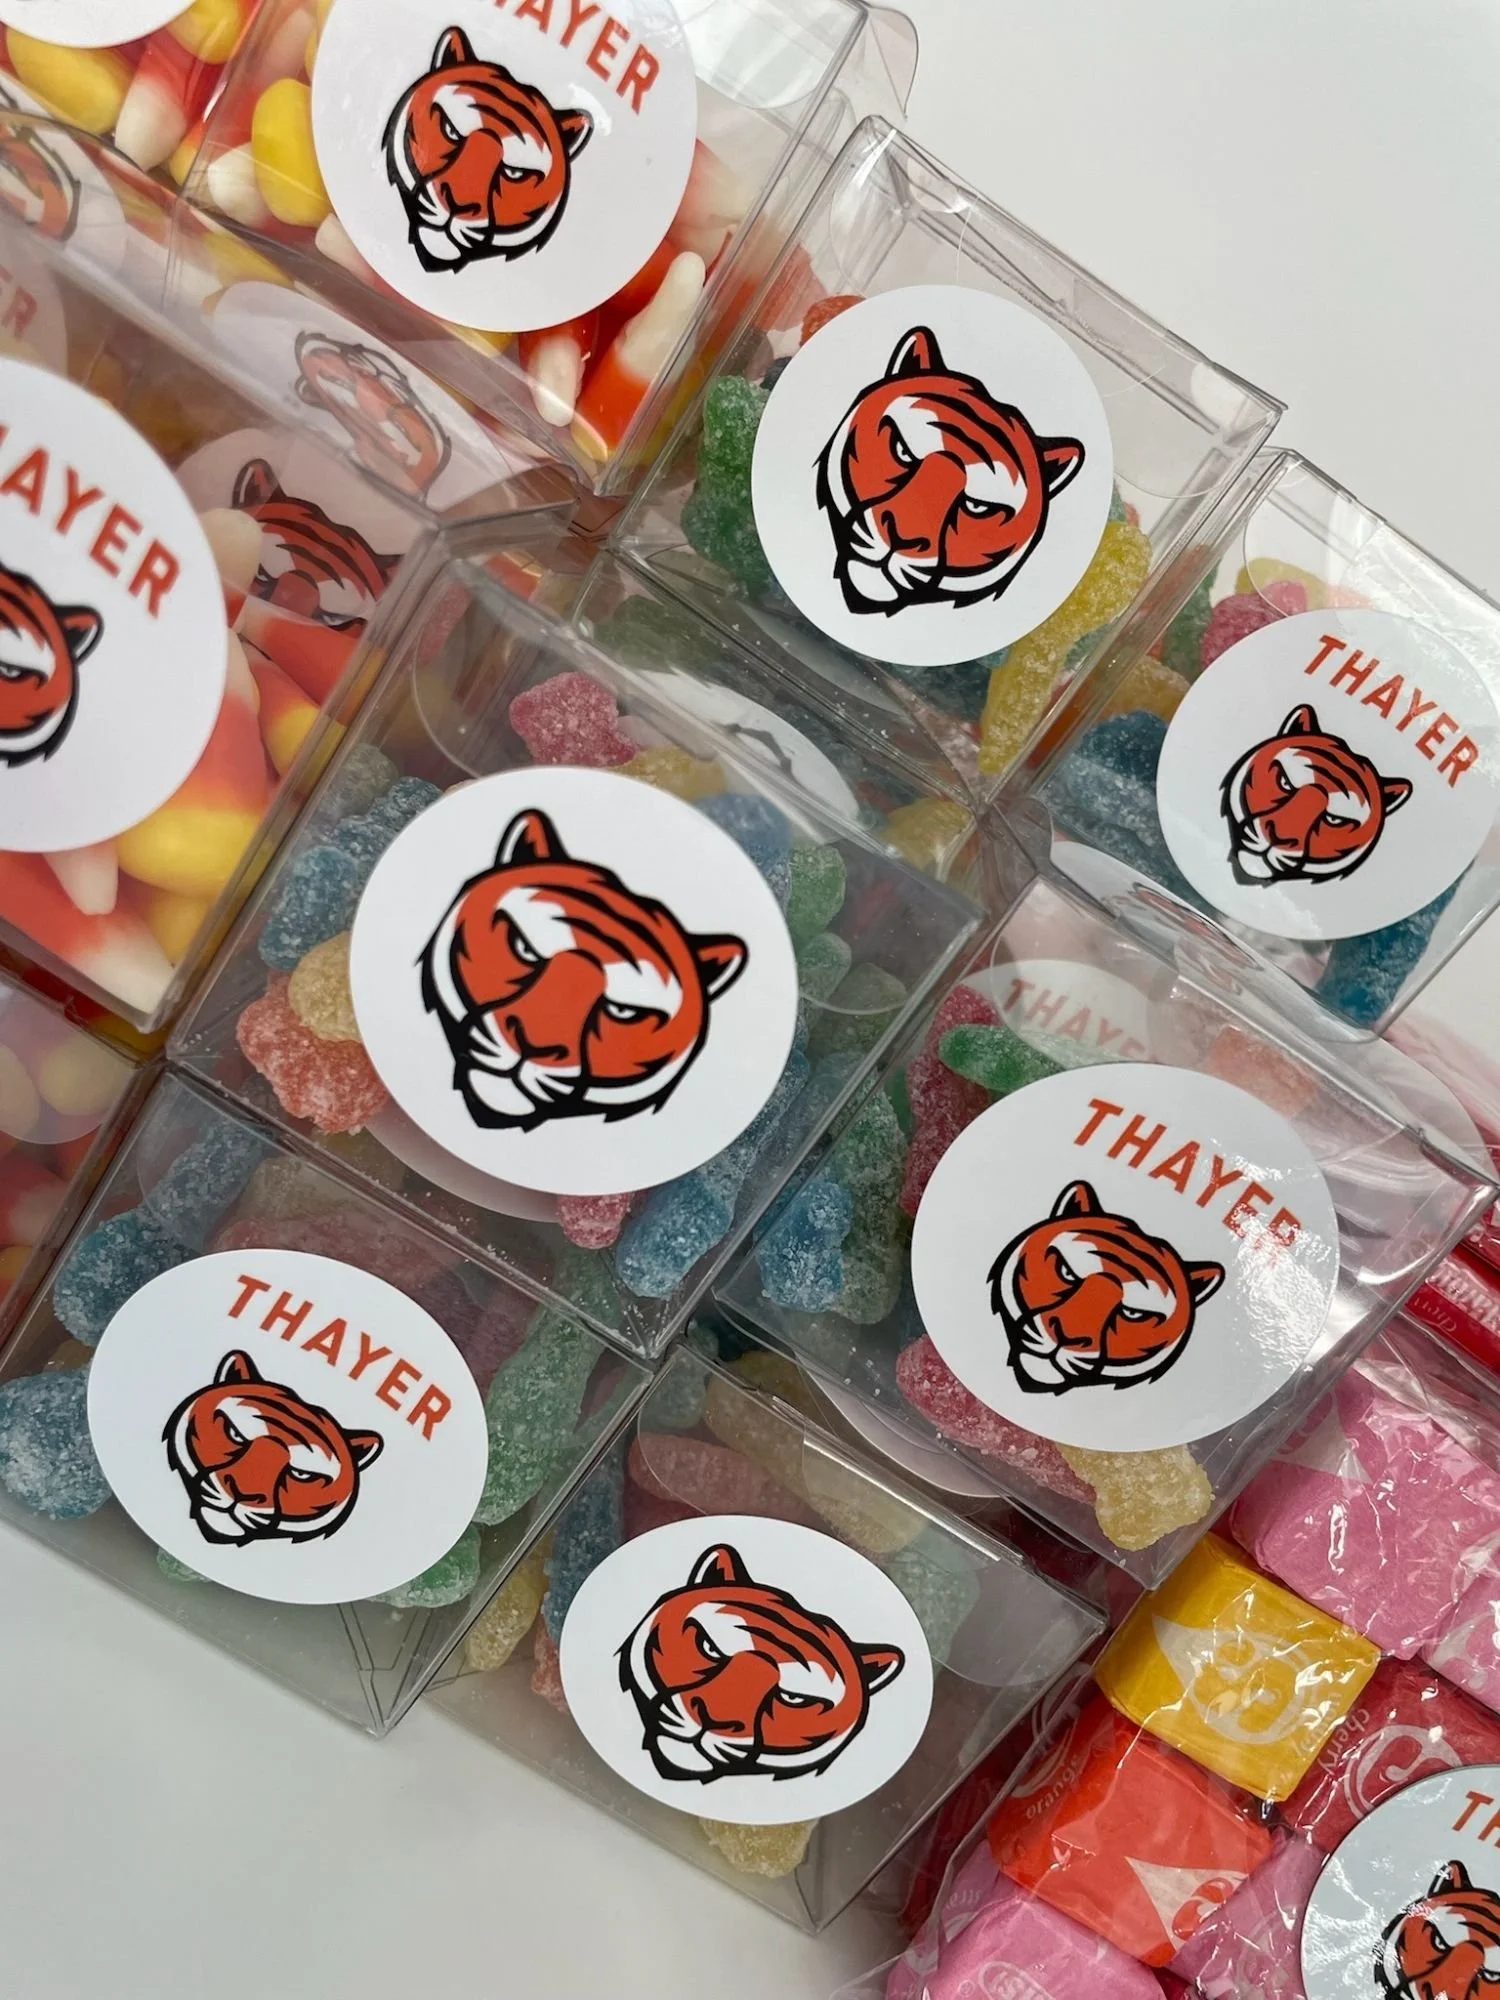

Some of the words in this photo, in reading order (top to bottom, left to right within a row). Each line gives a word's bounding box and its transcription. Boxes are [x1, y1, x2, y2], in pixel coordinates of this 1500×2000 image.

[494, 0, 660, 116] AYER
[0, 424, 181, 619] AYER
[1304, 634, 1479, 788] THAYER
[1002, 977, 1158, 1063] THAY
[228, 1274, 452, 1441] THAYER
[1316, 1707, 1371, 1776] cherry
